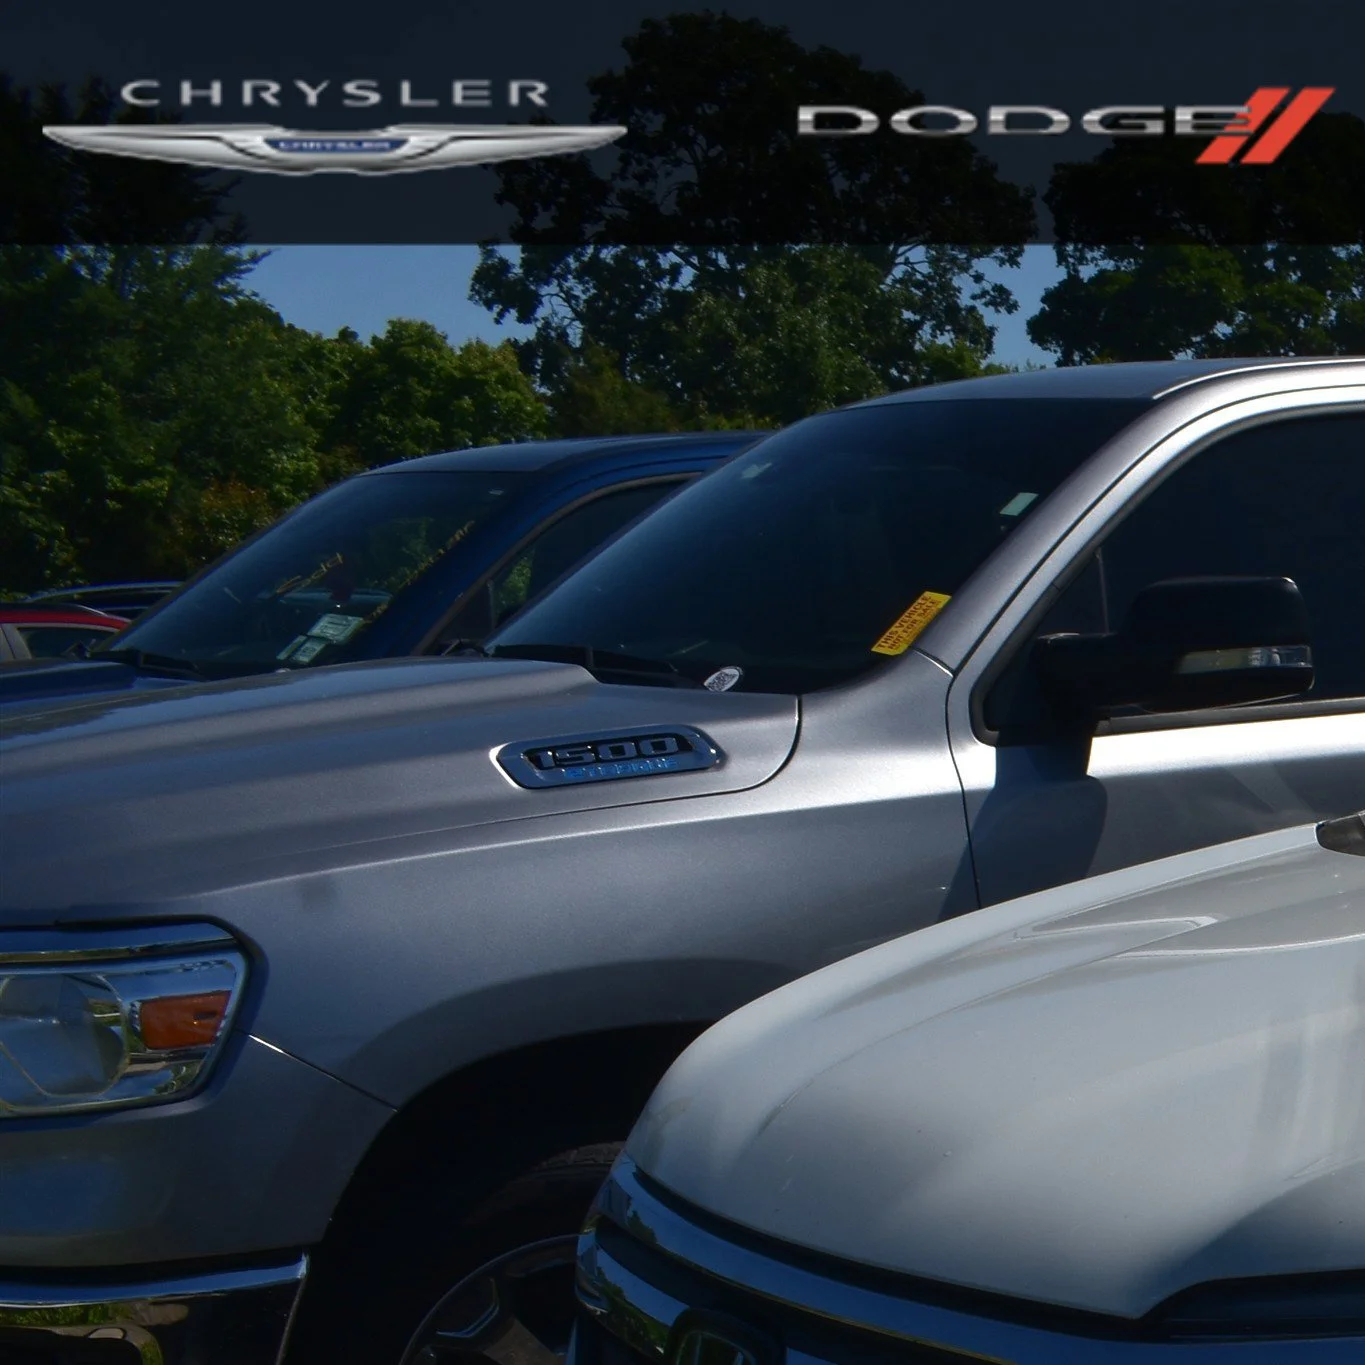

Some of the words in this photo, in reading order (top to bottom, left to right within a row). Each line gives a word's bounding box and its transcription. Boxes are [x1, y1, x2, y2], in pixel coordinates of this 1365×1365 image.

[876, 630, 899, 648] THIS
[894, 596, 932, 629] VEHICLE
[536, 736, 680, 769] 1500
